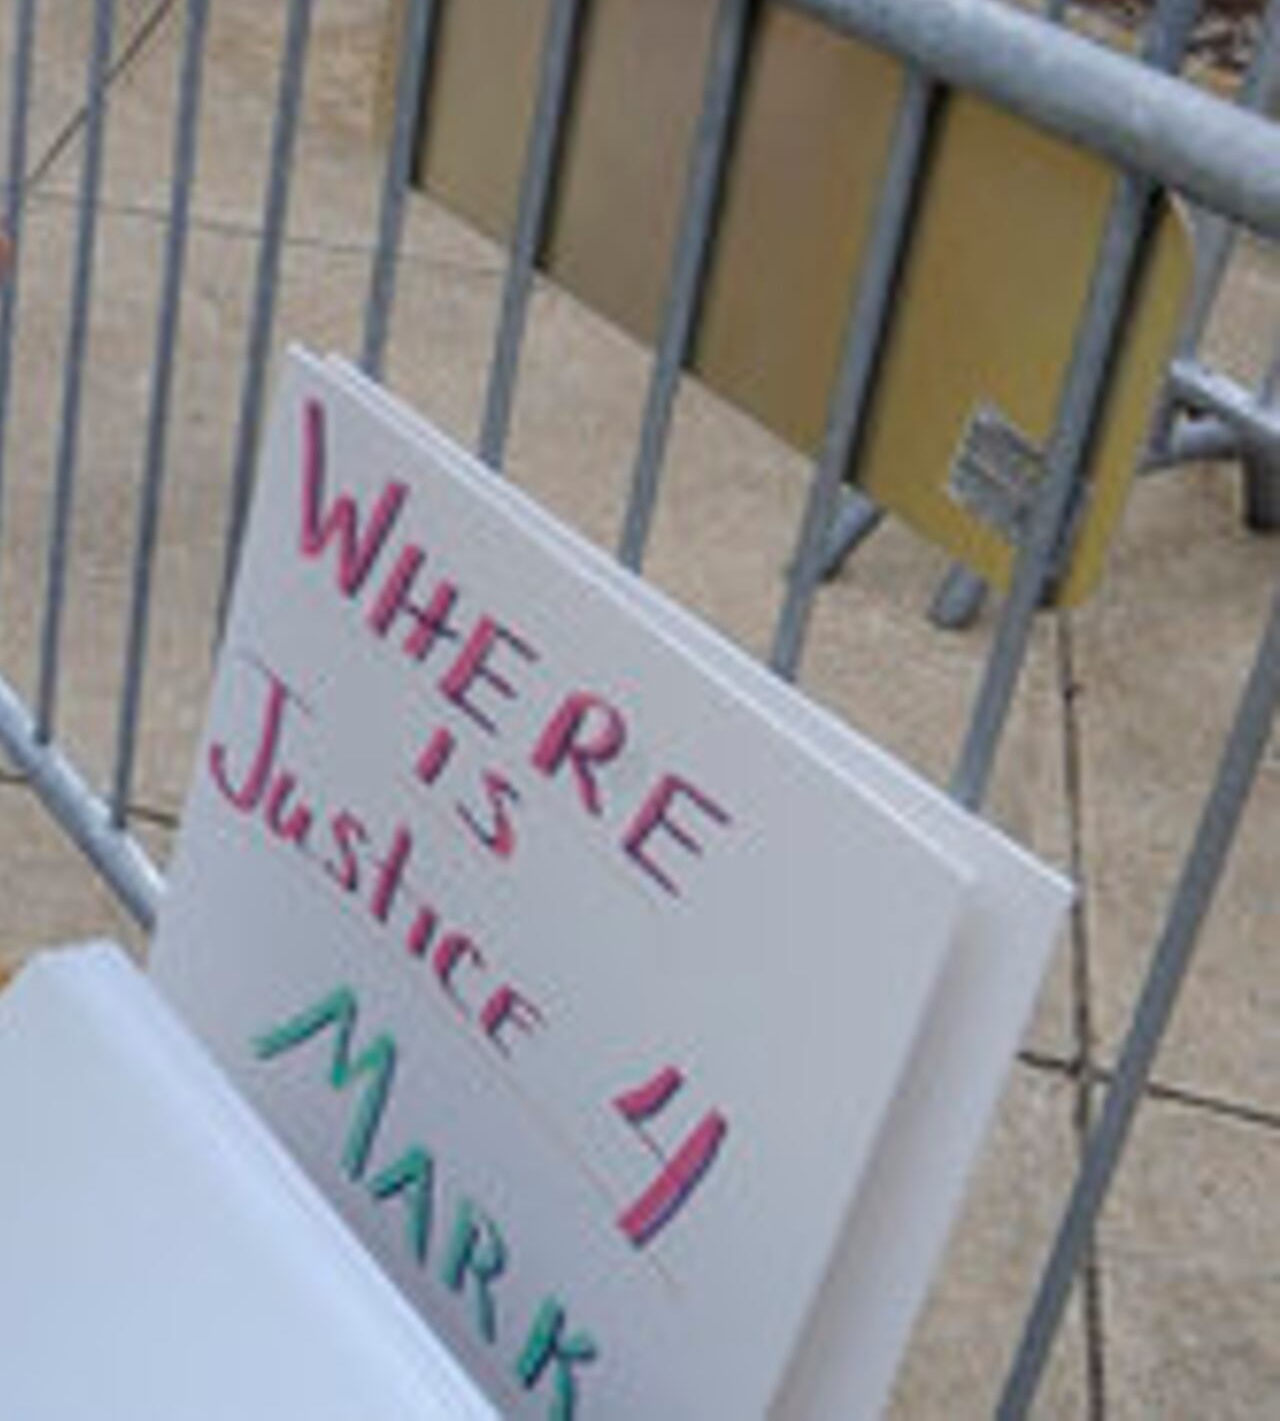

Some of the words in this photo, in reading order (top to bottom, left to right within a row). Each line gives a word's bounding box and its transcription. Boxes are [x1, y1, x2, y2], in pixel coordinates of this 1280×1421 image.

[299, 397, 735, 898] WHERE
[253, 983, 598, 1421] MARK
[612, 1063, 730, 1249] 4
